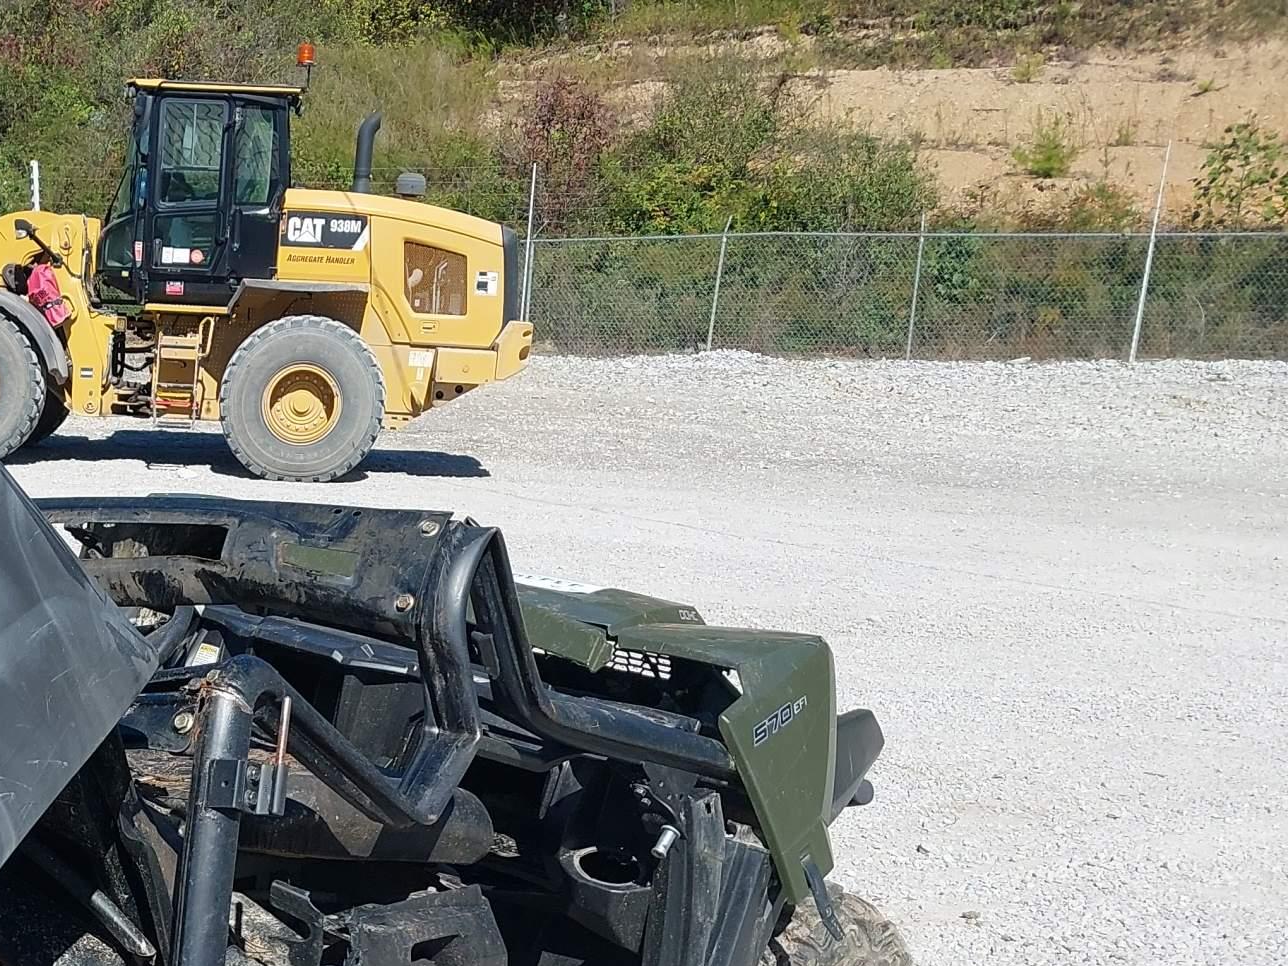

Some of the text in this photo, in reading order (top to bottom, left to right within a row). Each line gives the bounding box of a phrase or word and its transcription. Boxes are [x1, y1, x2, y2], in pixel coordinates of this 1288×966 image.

[287, 216, 362, 242] CAT 938M
[753, 695, 808, 747] 570 EFI
